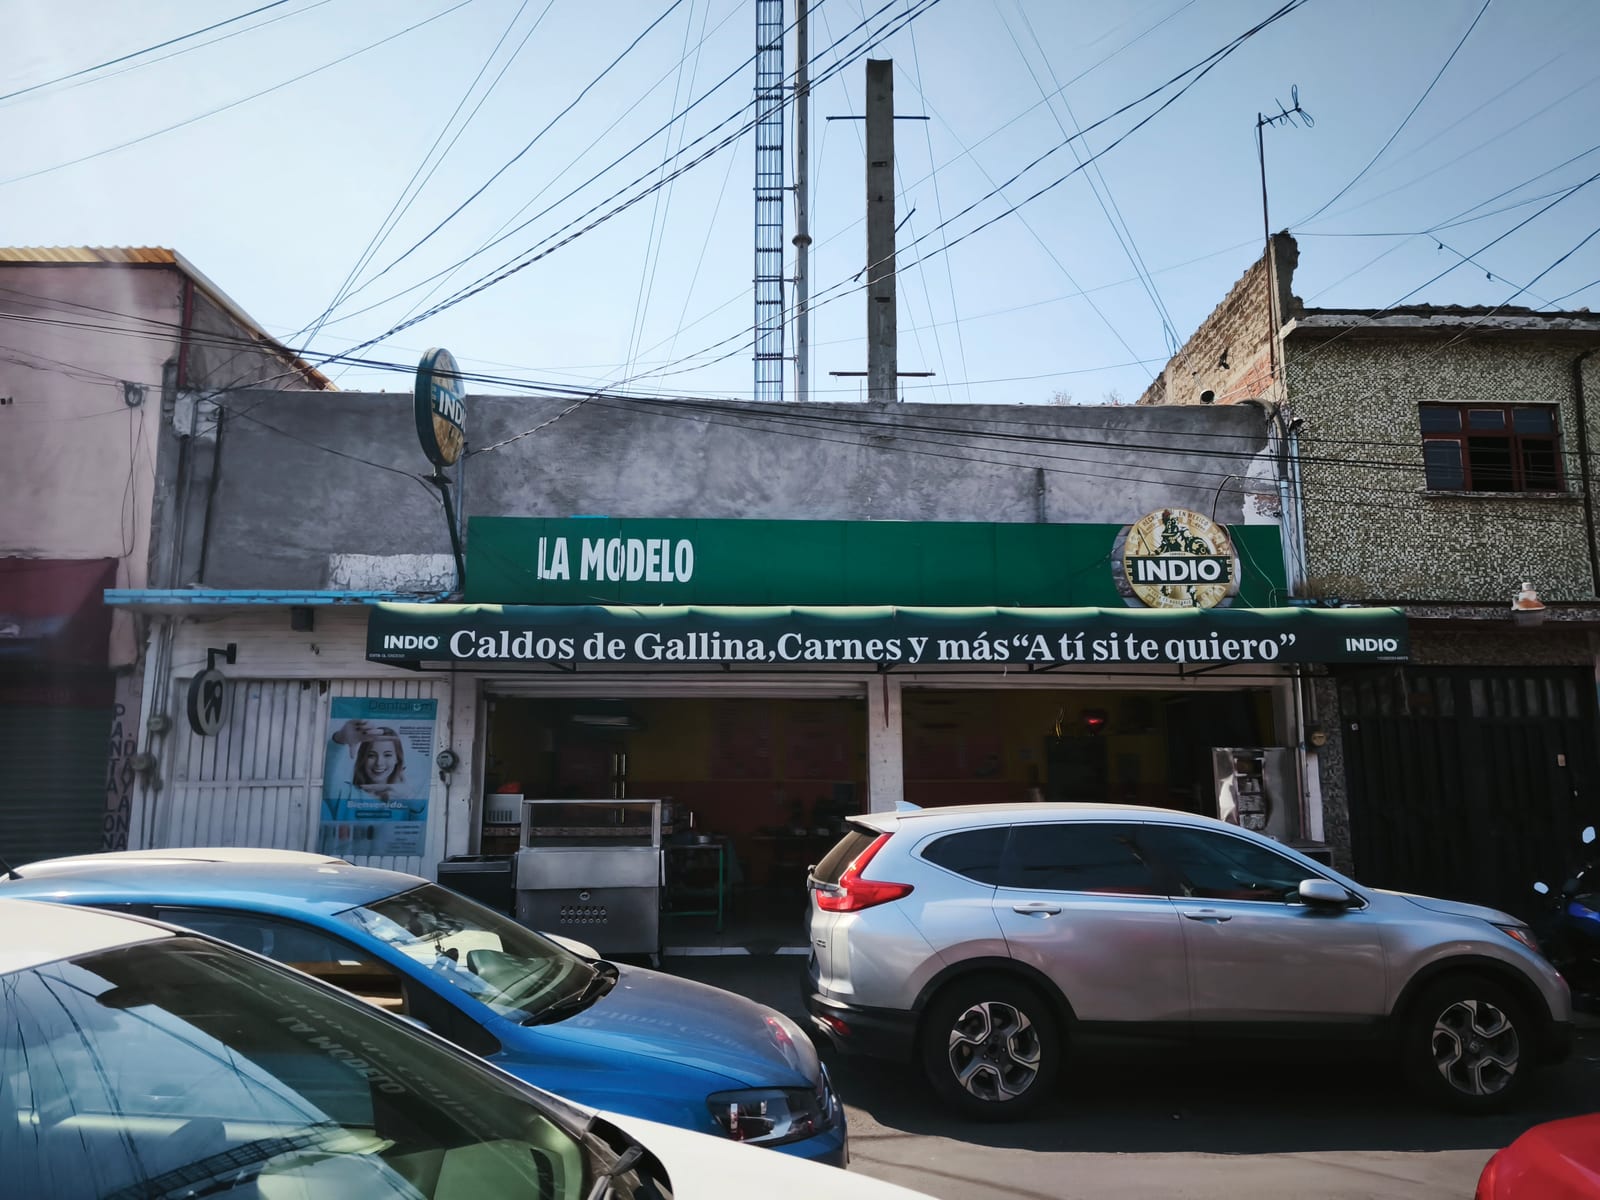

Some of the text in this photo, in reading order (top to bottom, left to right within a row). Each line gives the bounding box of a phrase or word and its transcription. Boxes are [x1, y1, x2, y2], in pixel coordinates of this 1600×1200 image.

[537, 536, 694, 583] LA MODELO
[1137, 559, 1220, 581] INDIO
[384, 635, 439, 650] INDIO
[449, 629, 575, 660] Caldos
[583, 632, 625, 660] de
[777, 632, 901, 661] Carnes
[907, 637, 928, 663] y
[937, 632, 1010, 661] más
[1059, 632, 1085, 661] tí
[1345, 638, 1398, 652] INDIO
